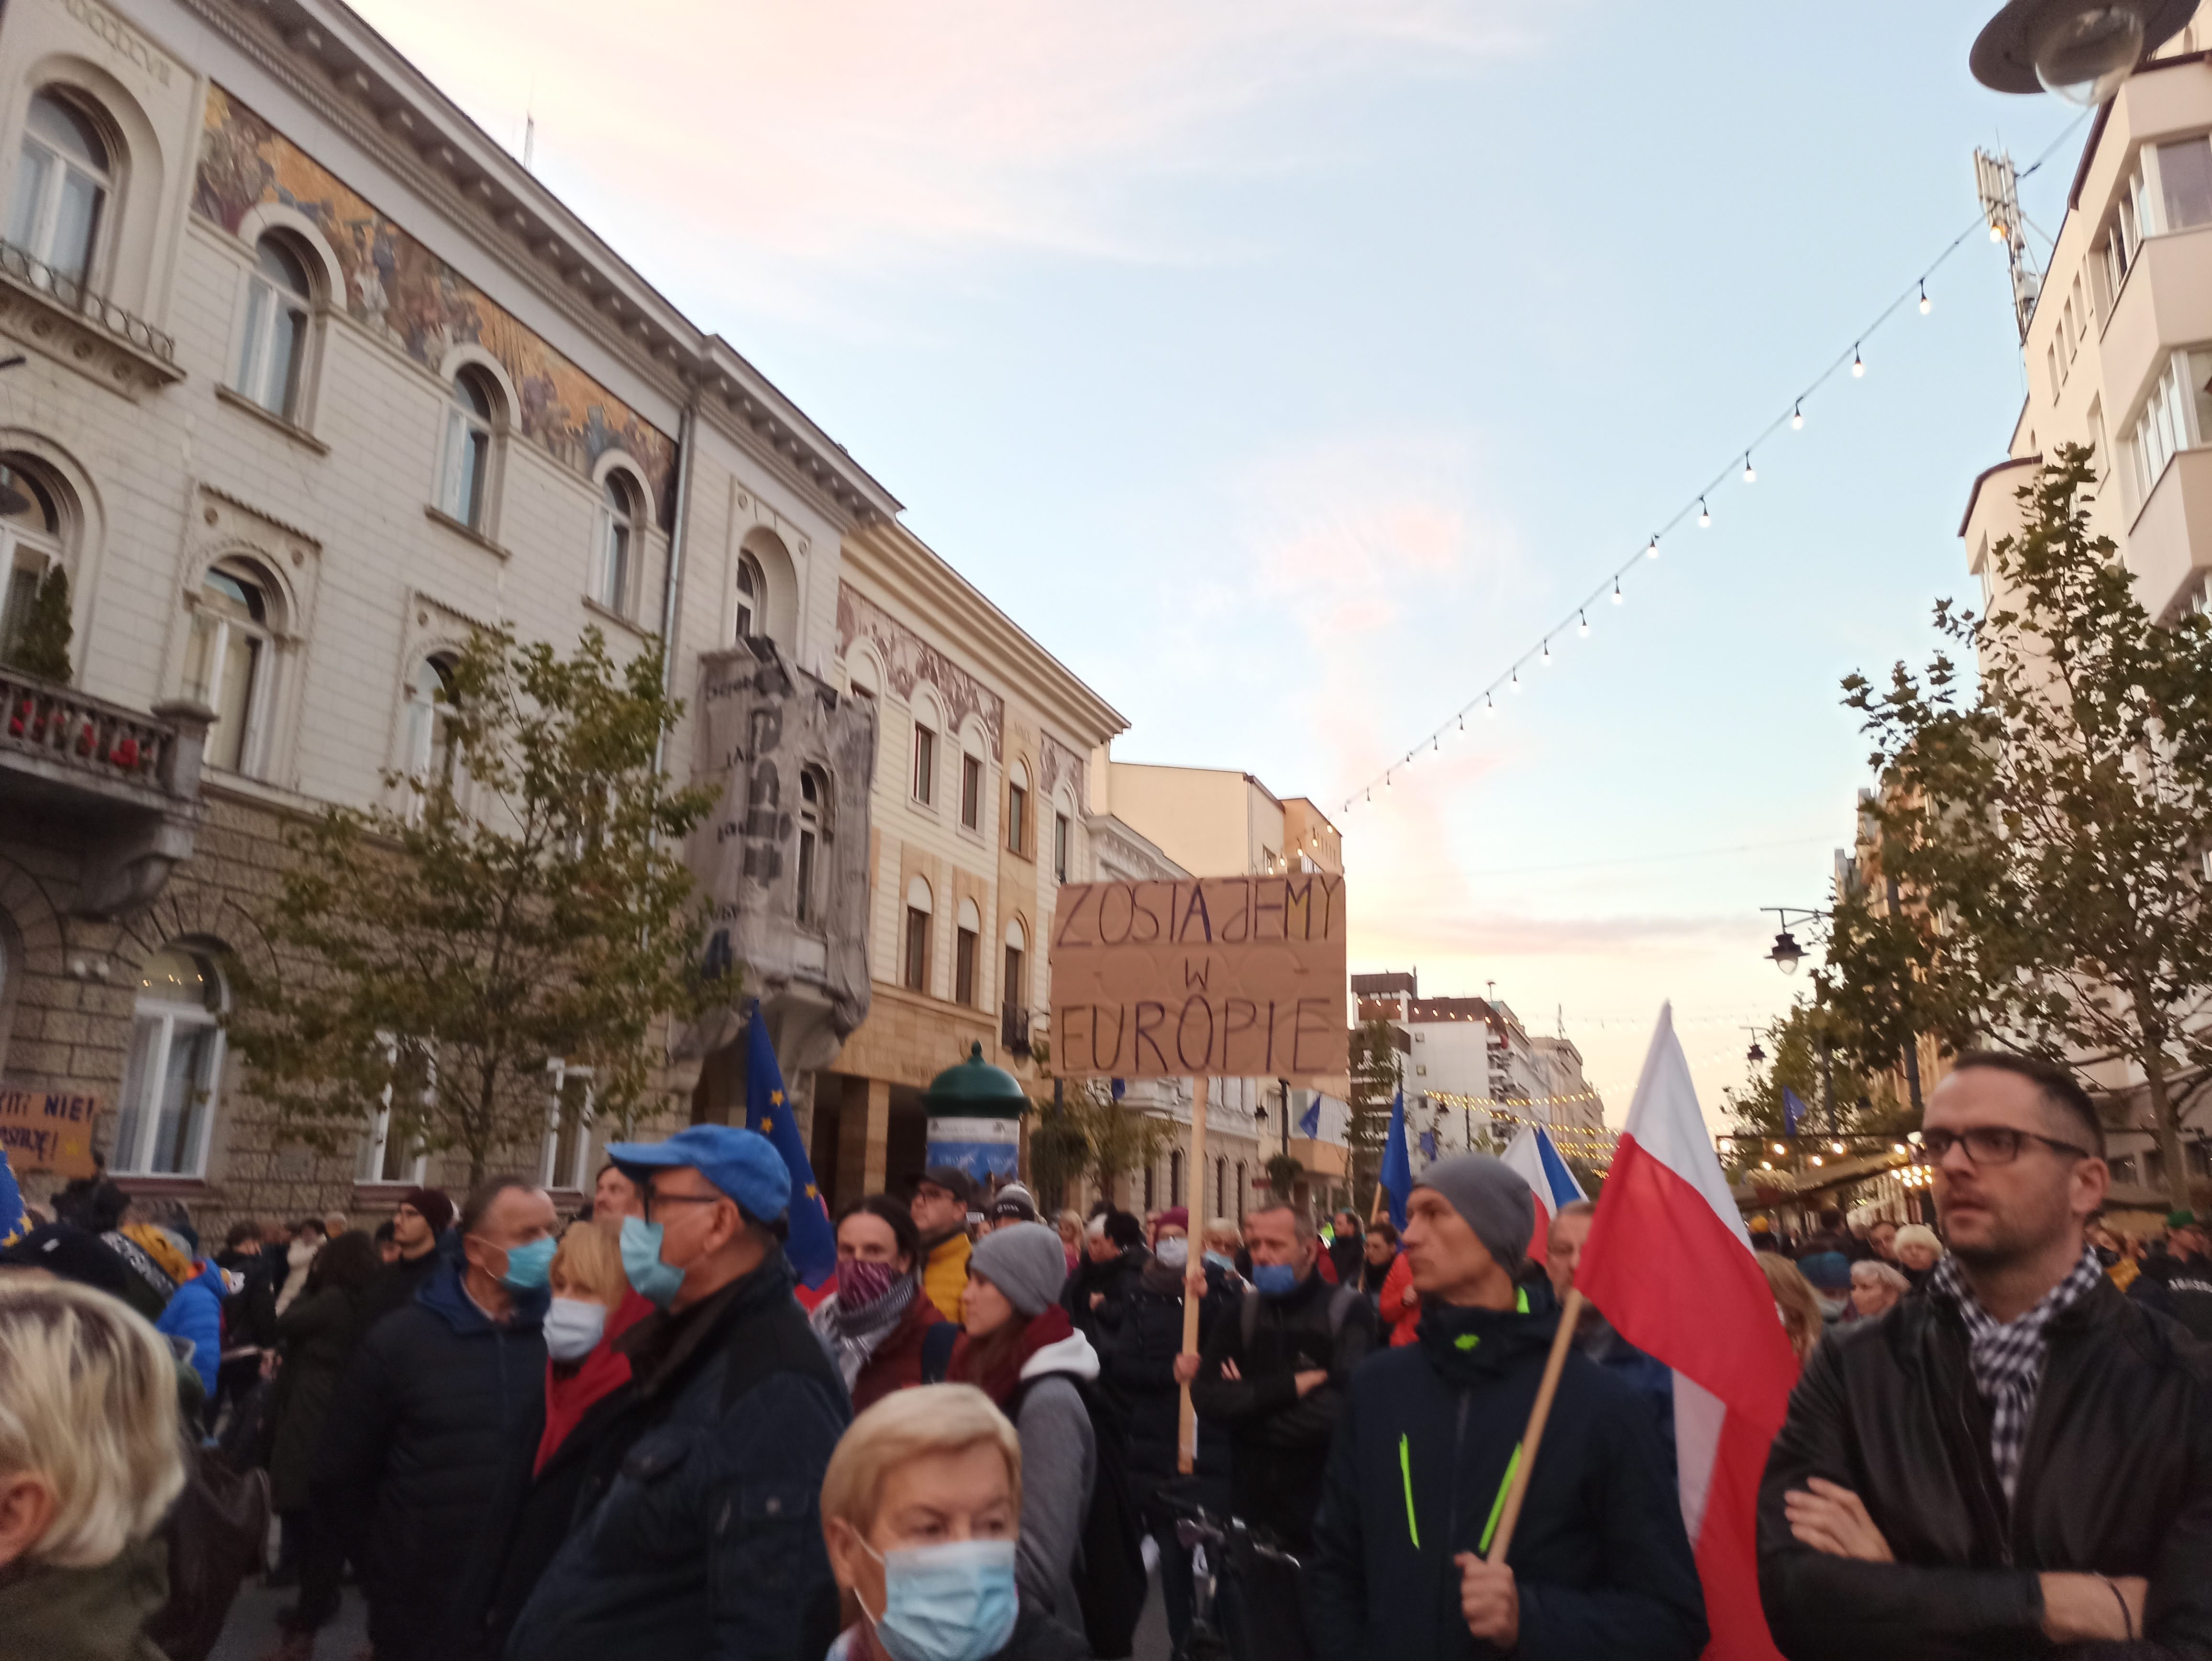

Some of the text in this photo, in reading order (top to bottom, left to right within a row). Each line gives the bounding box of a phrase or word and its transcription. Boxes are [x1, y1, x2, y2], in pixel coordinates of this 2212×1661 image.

[1056, 875, 1342, 948] ZOSTAJEMY
[1184, 956, 1210, 992] W
[1060, 994, 1331, 1074] EUROPIE
